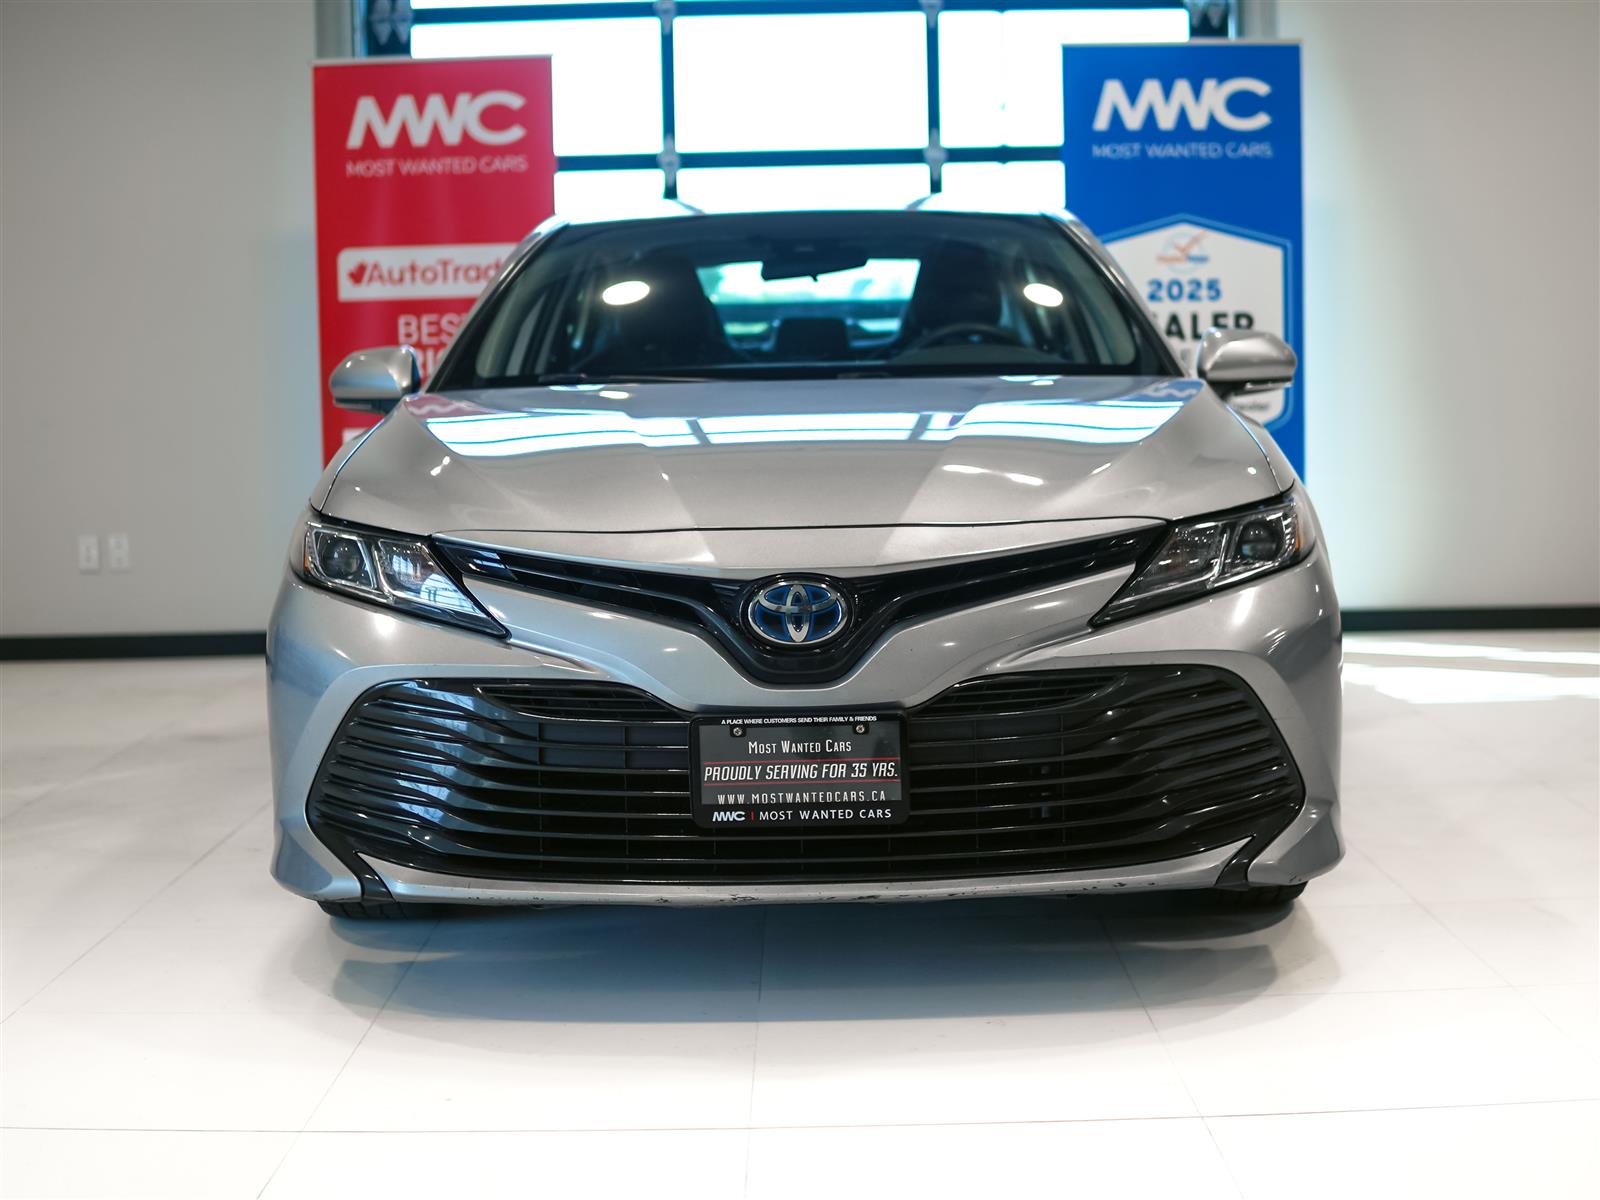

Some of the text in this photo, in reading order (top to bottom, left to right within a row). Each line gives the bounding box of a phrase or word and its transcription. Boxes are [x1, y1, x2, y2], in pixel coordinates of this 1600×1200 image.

[1092, 77, 1272, 132] MWC
[346, 90, 526, 149] MWC
[1092, 142, 1273, 159] MOST WANTED CARS
[345, 154, 528, 177] MOST WANTED CARS
[1147, 278, 1221, 302] 2025
[398, 313, 467, 345] BES
[704, 762, 898, 782] PROUDLY SERVING FOR 35 YRS.
[717, 790, 886, 805] WWW.MOSTWANTEDCARS.CA
[712, 808, 892, 822] MWC MOST WANTED CARS
